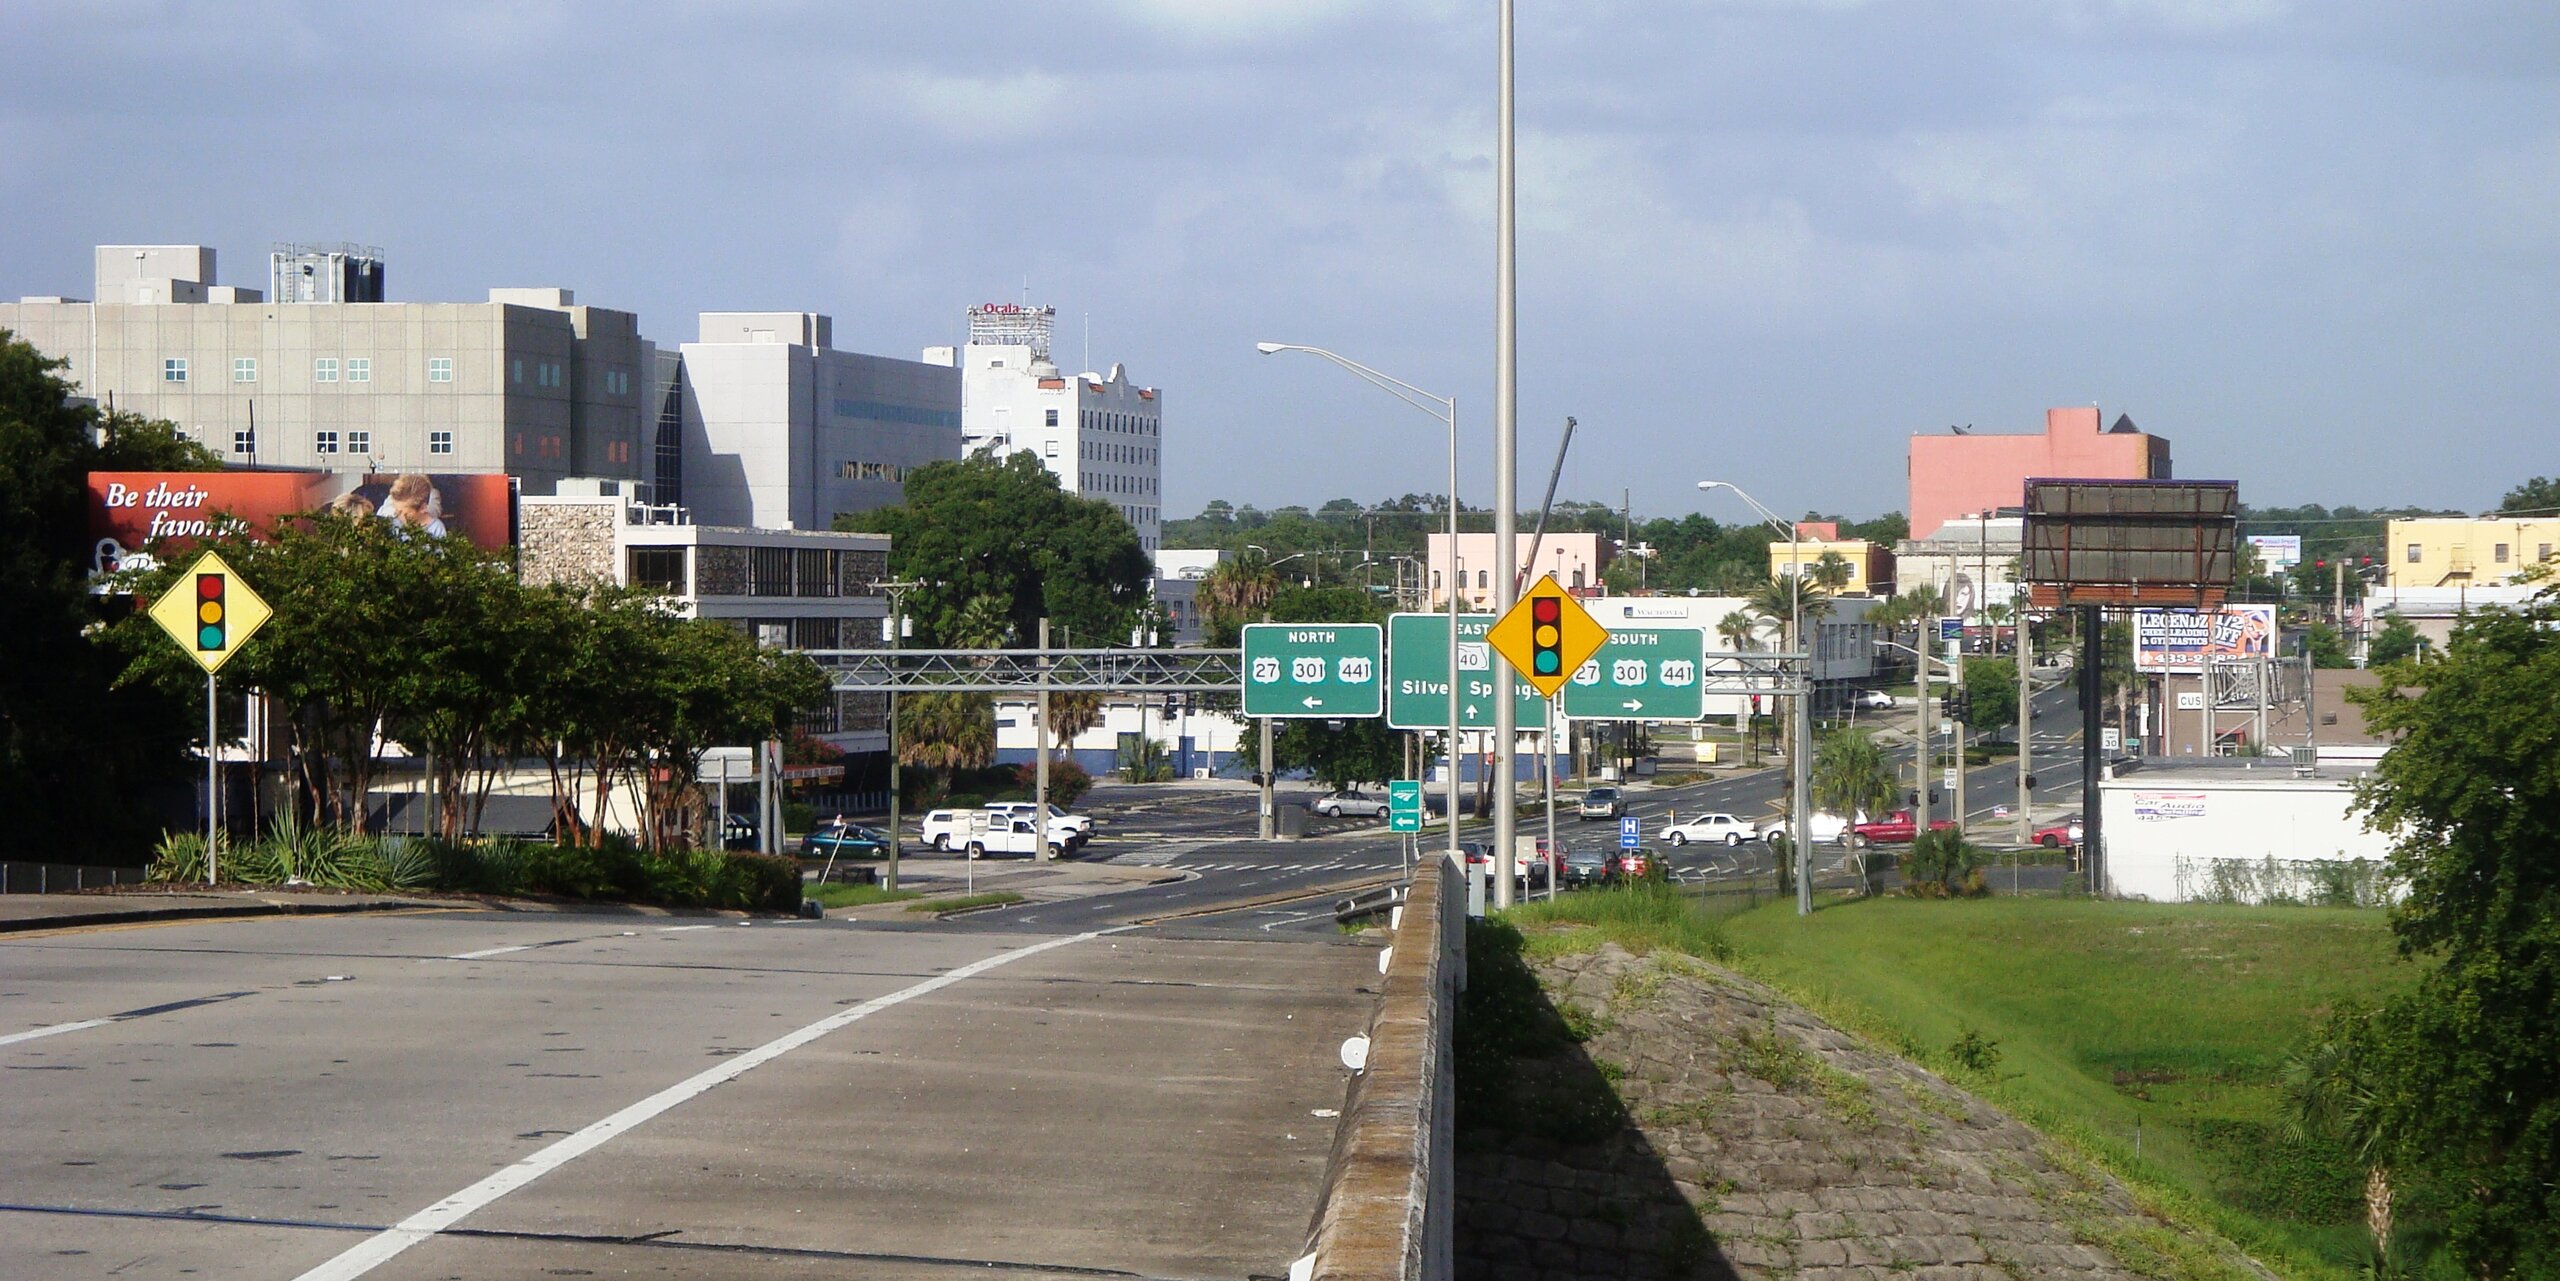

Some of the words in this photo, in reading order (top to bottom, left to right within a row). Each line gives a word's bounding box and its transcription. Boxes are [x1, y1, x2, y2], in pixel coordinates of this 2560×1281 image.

[983, 302, 1020, 314] Ocala
[105, 483, 138, 508] Be
[145, 481, 208, 508] their
[1457, 623, 1490, 635] EAST
[2141, 628, 2209, 637] CHEELEADING
[1288, 631, 1336, 643] NORTH
[1610, 633, 1659, 645] SOUTH
[1460, 653, 1478, 666] 40
[1256, 664, 1277, 678] 27
[1295, 663, 1324, 678] 301
[1342, 664, 1370, 678] 441
[1575, 665, 1597, 680] 27
[1616, 666, 1644, 680] 301
[1664, 667, 1692, 680] 441
[1401, 680, 1449, 695] Silve
[1469, 680, 1542, 701] Spgs
[2105, 739, 2117, 747] 30
[2135, 798, 2160, 806] Car
[1624, 819, 1636, 834] H
